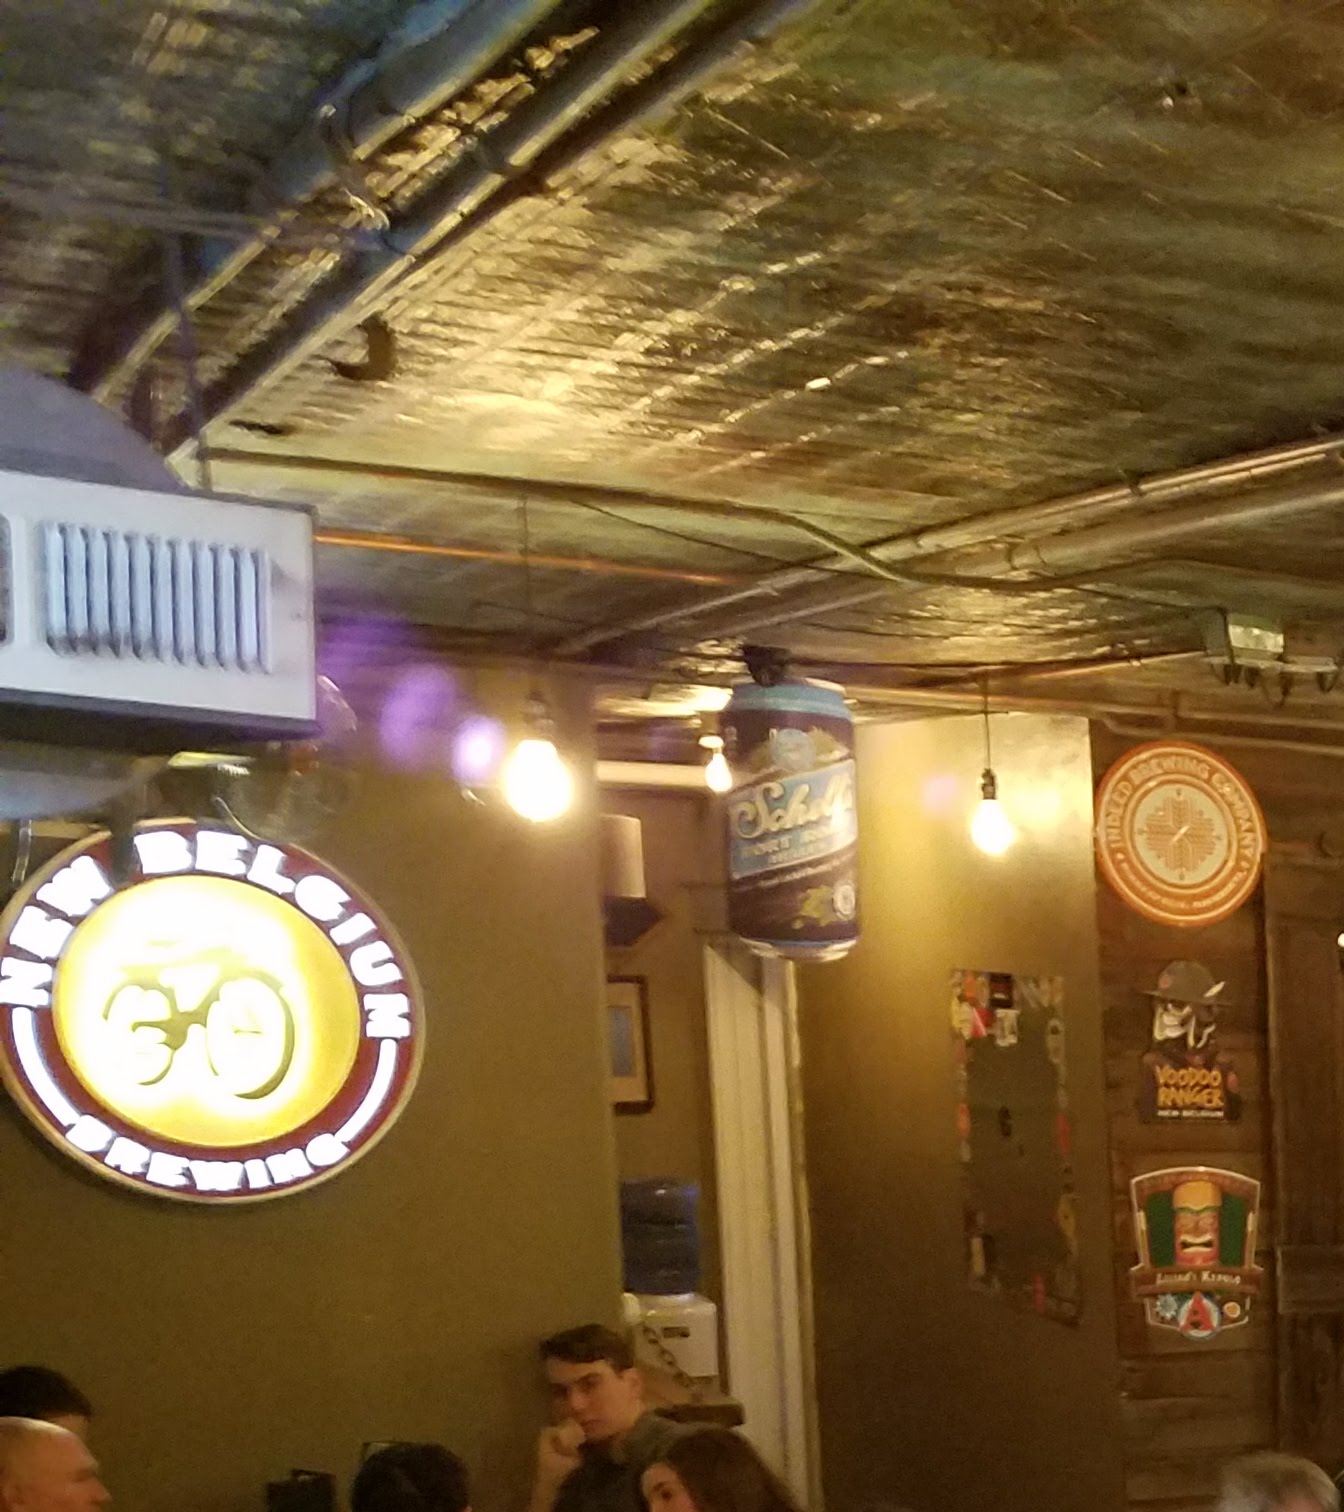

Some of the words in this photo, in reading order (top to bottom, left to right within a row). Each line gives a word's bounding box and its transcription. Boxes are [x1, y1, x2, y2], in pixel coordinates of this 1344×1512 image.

[1128, 755, 1210, 785] BREWING
[1211, 772, 1256, 858] COMPANY
[0, 855, 113, 1007] NEW
[134, 830, 411, 1039] BELGIUM
[1156, 1066, 1222, 1087] VOODOO
[1158, 1086, 1224, 1108] RANGER
[65, 1115, 351, 1191] BREWING
